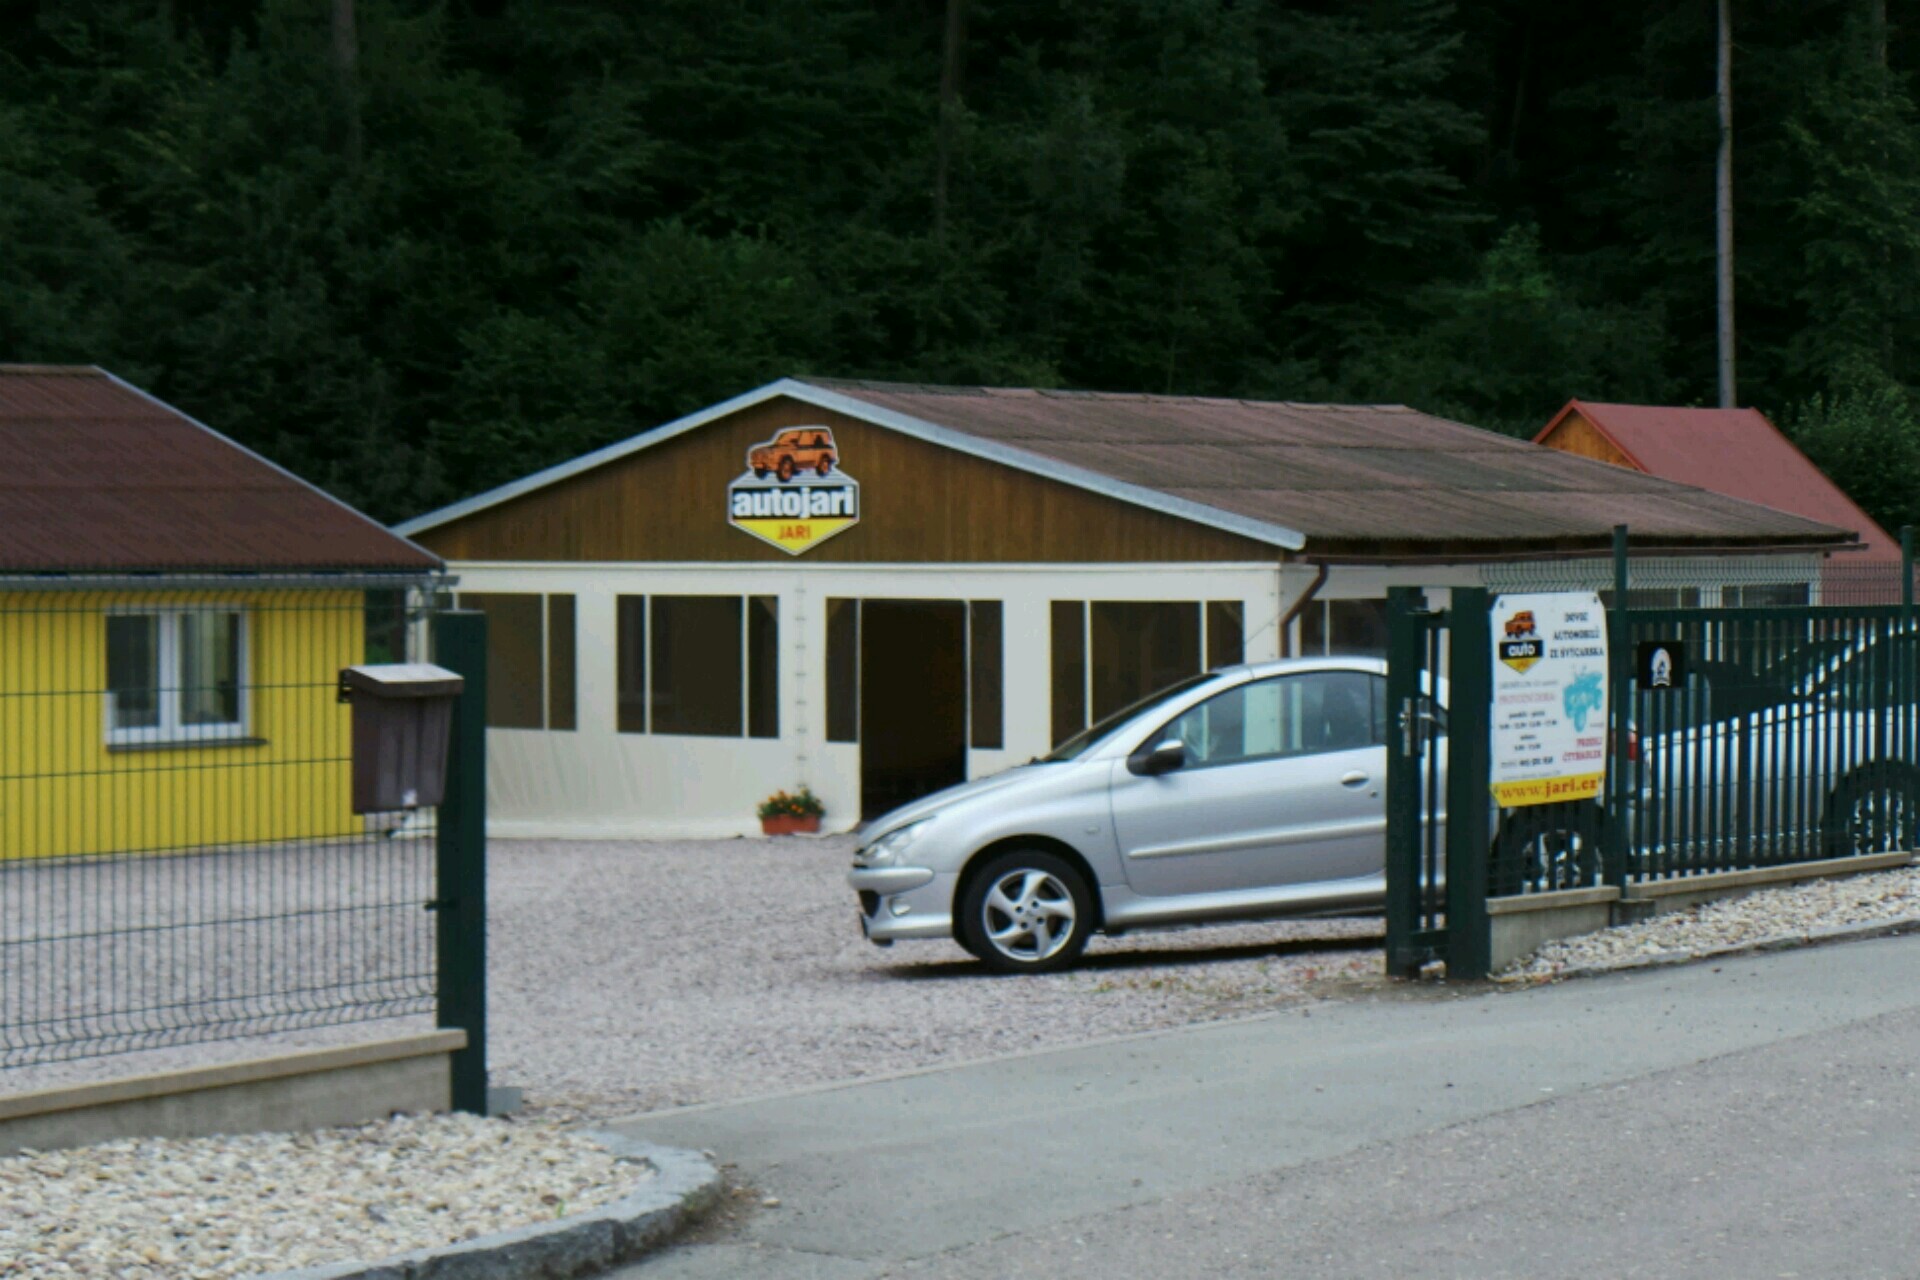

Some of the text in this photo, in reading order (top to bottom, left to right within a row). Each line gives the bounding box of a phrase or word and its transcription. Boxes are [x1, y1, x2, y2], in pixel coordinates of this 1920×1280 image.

[733, 485, 854, 519] autojari
[778, 525, 811, 540] JARI
[1501, 778, 1598, 799] www.jari.cz
